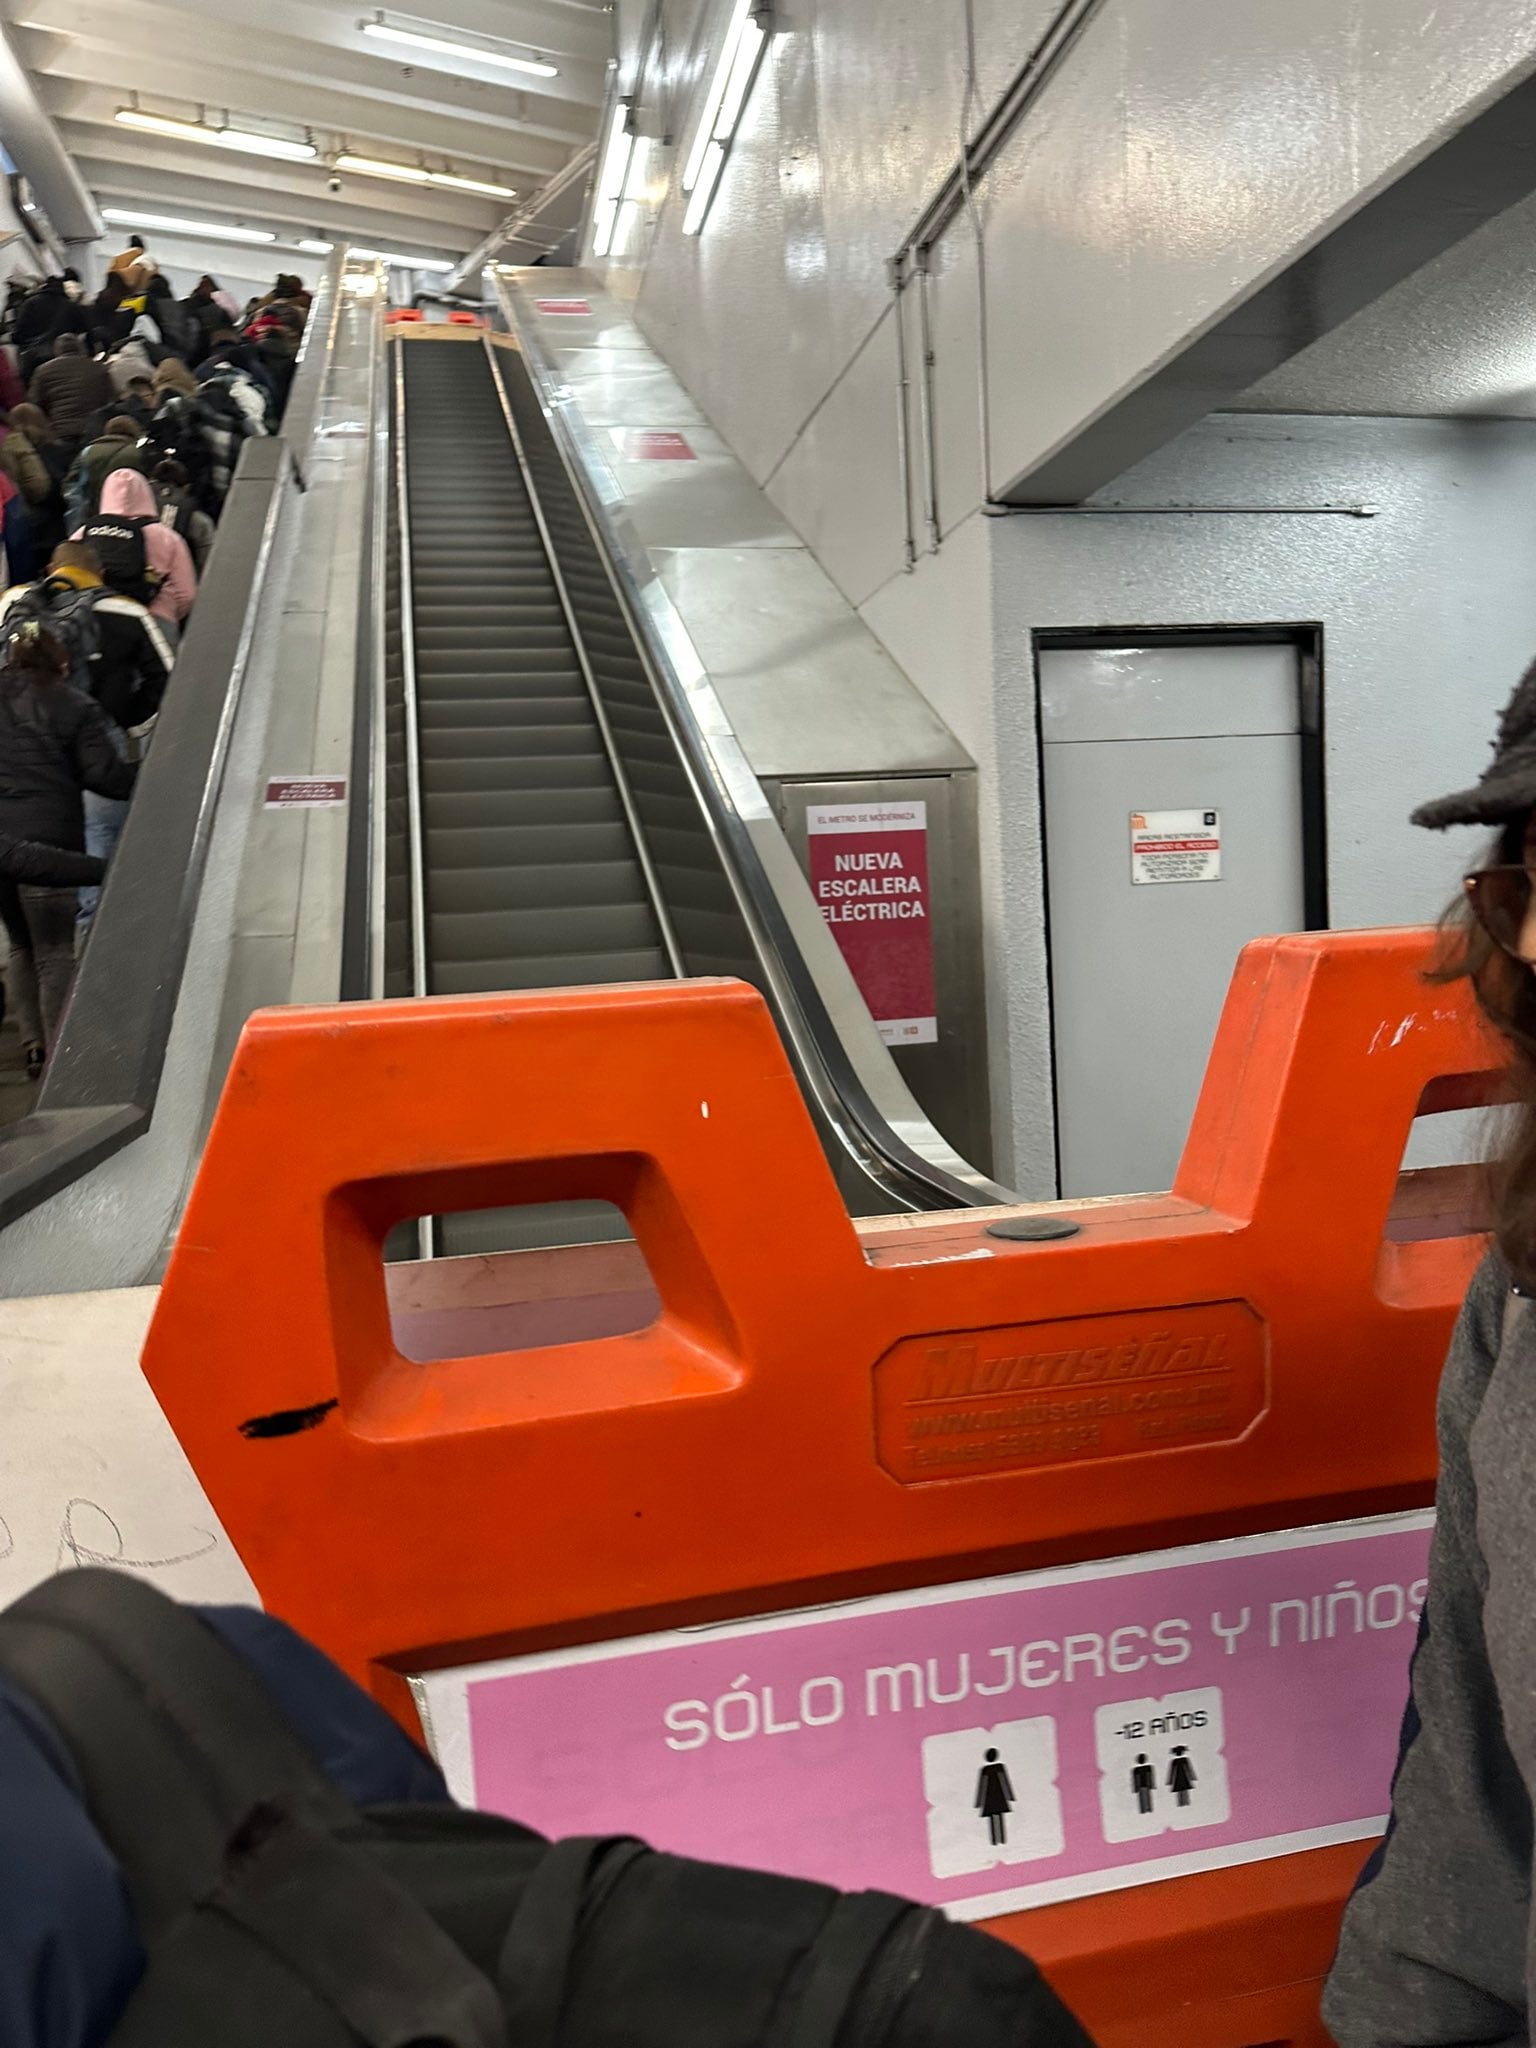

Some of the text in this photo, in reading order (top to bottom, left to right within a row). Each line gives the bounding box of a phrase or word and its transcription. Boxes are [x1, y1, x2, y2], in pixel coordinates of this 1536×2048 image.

[86, 525, 135, 539] adidas
[829, 814, 857, 824] METRO
[870, 812, 916, 822] MODERNIZA
[834, 851, 903, 872] NUEVA
[819, 876, 922, 898] ESCALERA
[820, 900, 925, 923] ELÉCTRICA
[664, 1673, 845, 1750] SÓLO
[865, 1619, 1192, 1716] MUJERES
[1211, 1606, 1251, 1654] Y
[1114, 1711, 1208, 1739] -12 AÑOS
